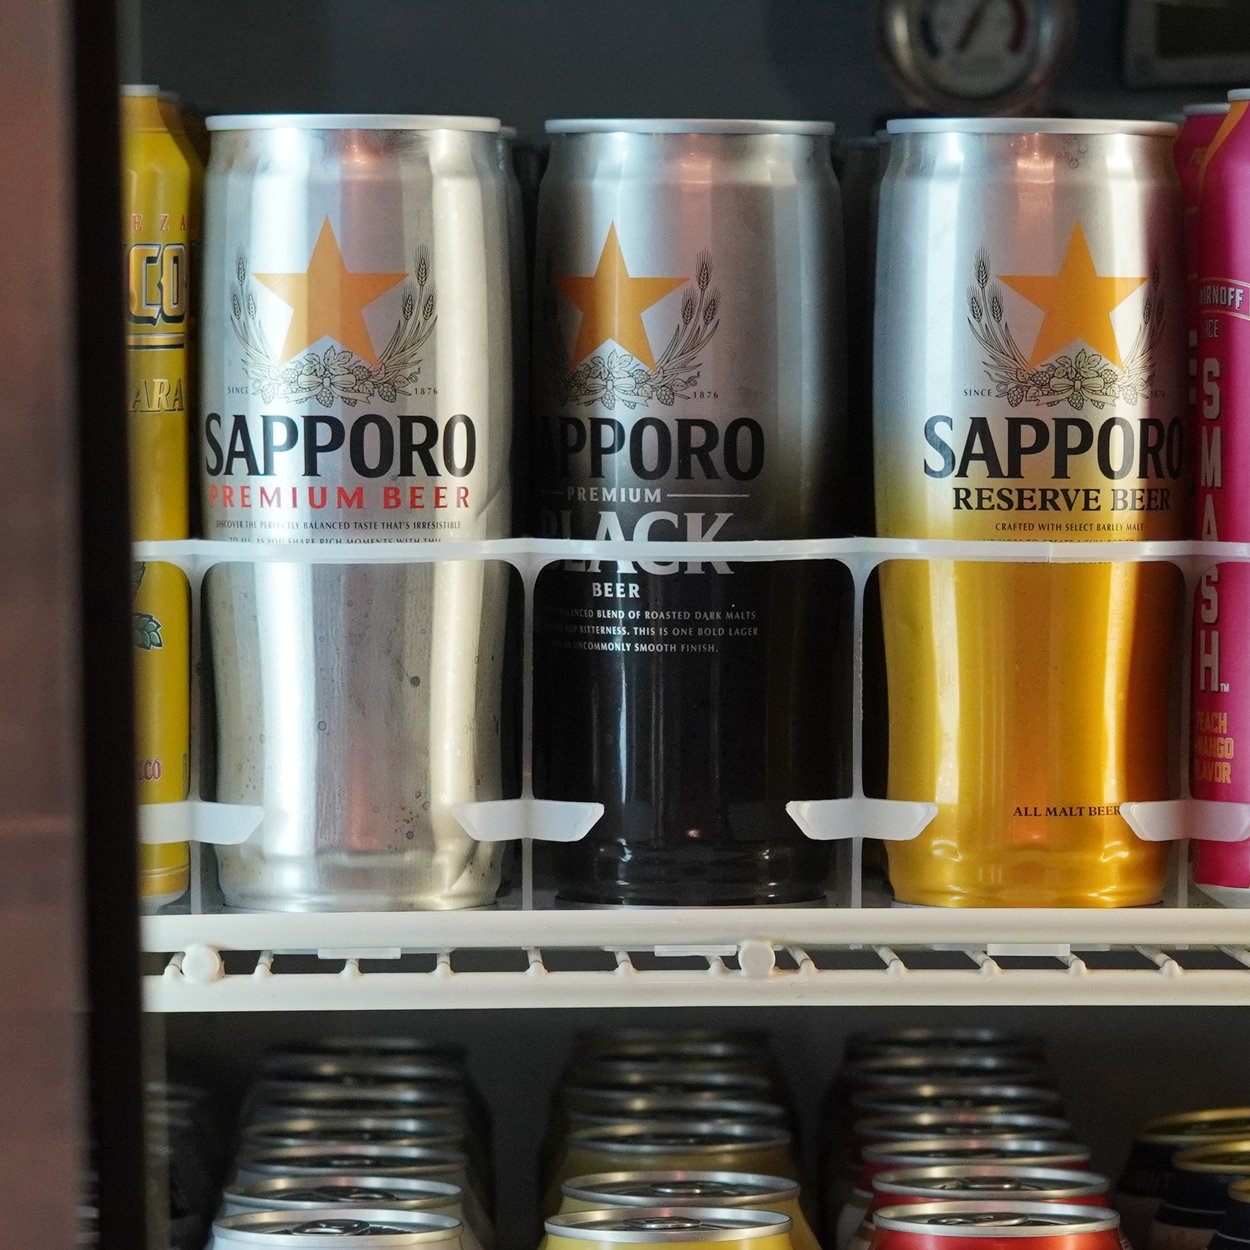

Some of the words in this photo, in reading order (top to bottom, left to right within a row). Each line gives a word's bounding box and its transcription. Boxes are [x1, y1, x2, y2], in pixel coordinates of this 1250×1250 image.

[414, 387, 439, 396] 1876
[963, 388, 993, 398] SINCE
[205, 412, 477, 479] SAPPORO
[548, 416, 765, 482] PPORO
[923, 414, 1184, 480] SAPPORO
[208, 484, 365, 510] PREMIUM
[382, 485, 471, 510] BEER
[567, 486, 662, 503] PREMIUM
[952, 487, 1101, 511] RESERVE
[1111, 487, 1171, 511] BEER
[303, 520, 350, 530] BALANCED
[353, 520, 379, 530] TASTE
[413, 520, 462, 530] IRRESISTIBLE
[995, 522, 1035, 532] CRAFTED
[1038, 522, 1062, 532] WITH
[1065, 522, 1094, 532] SELECT
[1096, 522, 1124, 532] BARLEY
[591, 582, 641, 598] BEER
[597, 610, 625, 620] BLEND
[628, 610, 642, 620] OF
[644, 610, 691, 620] ROASTED
[694, 610, 722, 620] DARK
[725, 611, 757, 620] MALTS
[633, 626, 656, 636] THIS
[672, 627, 693, 637] ONE
[697, 627, 725, 637] BOLD
[728, 627, 759, 637] LAGER
[634, 642, 677, 653] SMOOTH
[680, 643, 719, 653] FINISH.
[1013, 806, 1042, 817] ALL
[1045, 806, 1085, 817] MALT
[1088, 805, 1121, 817] BEER
